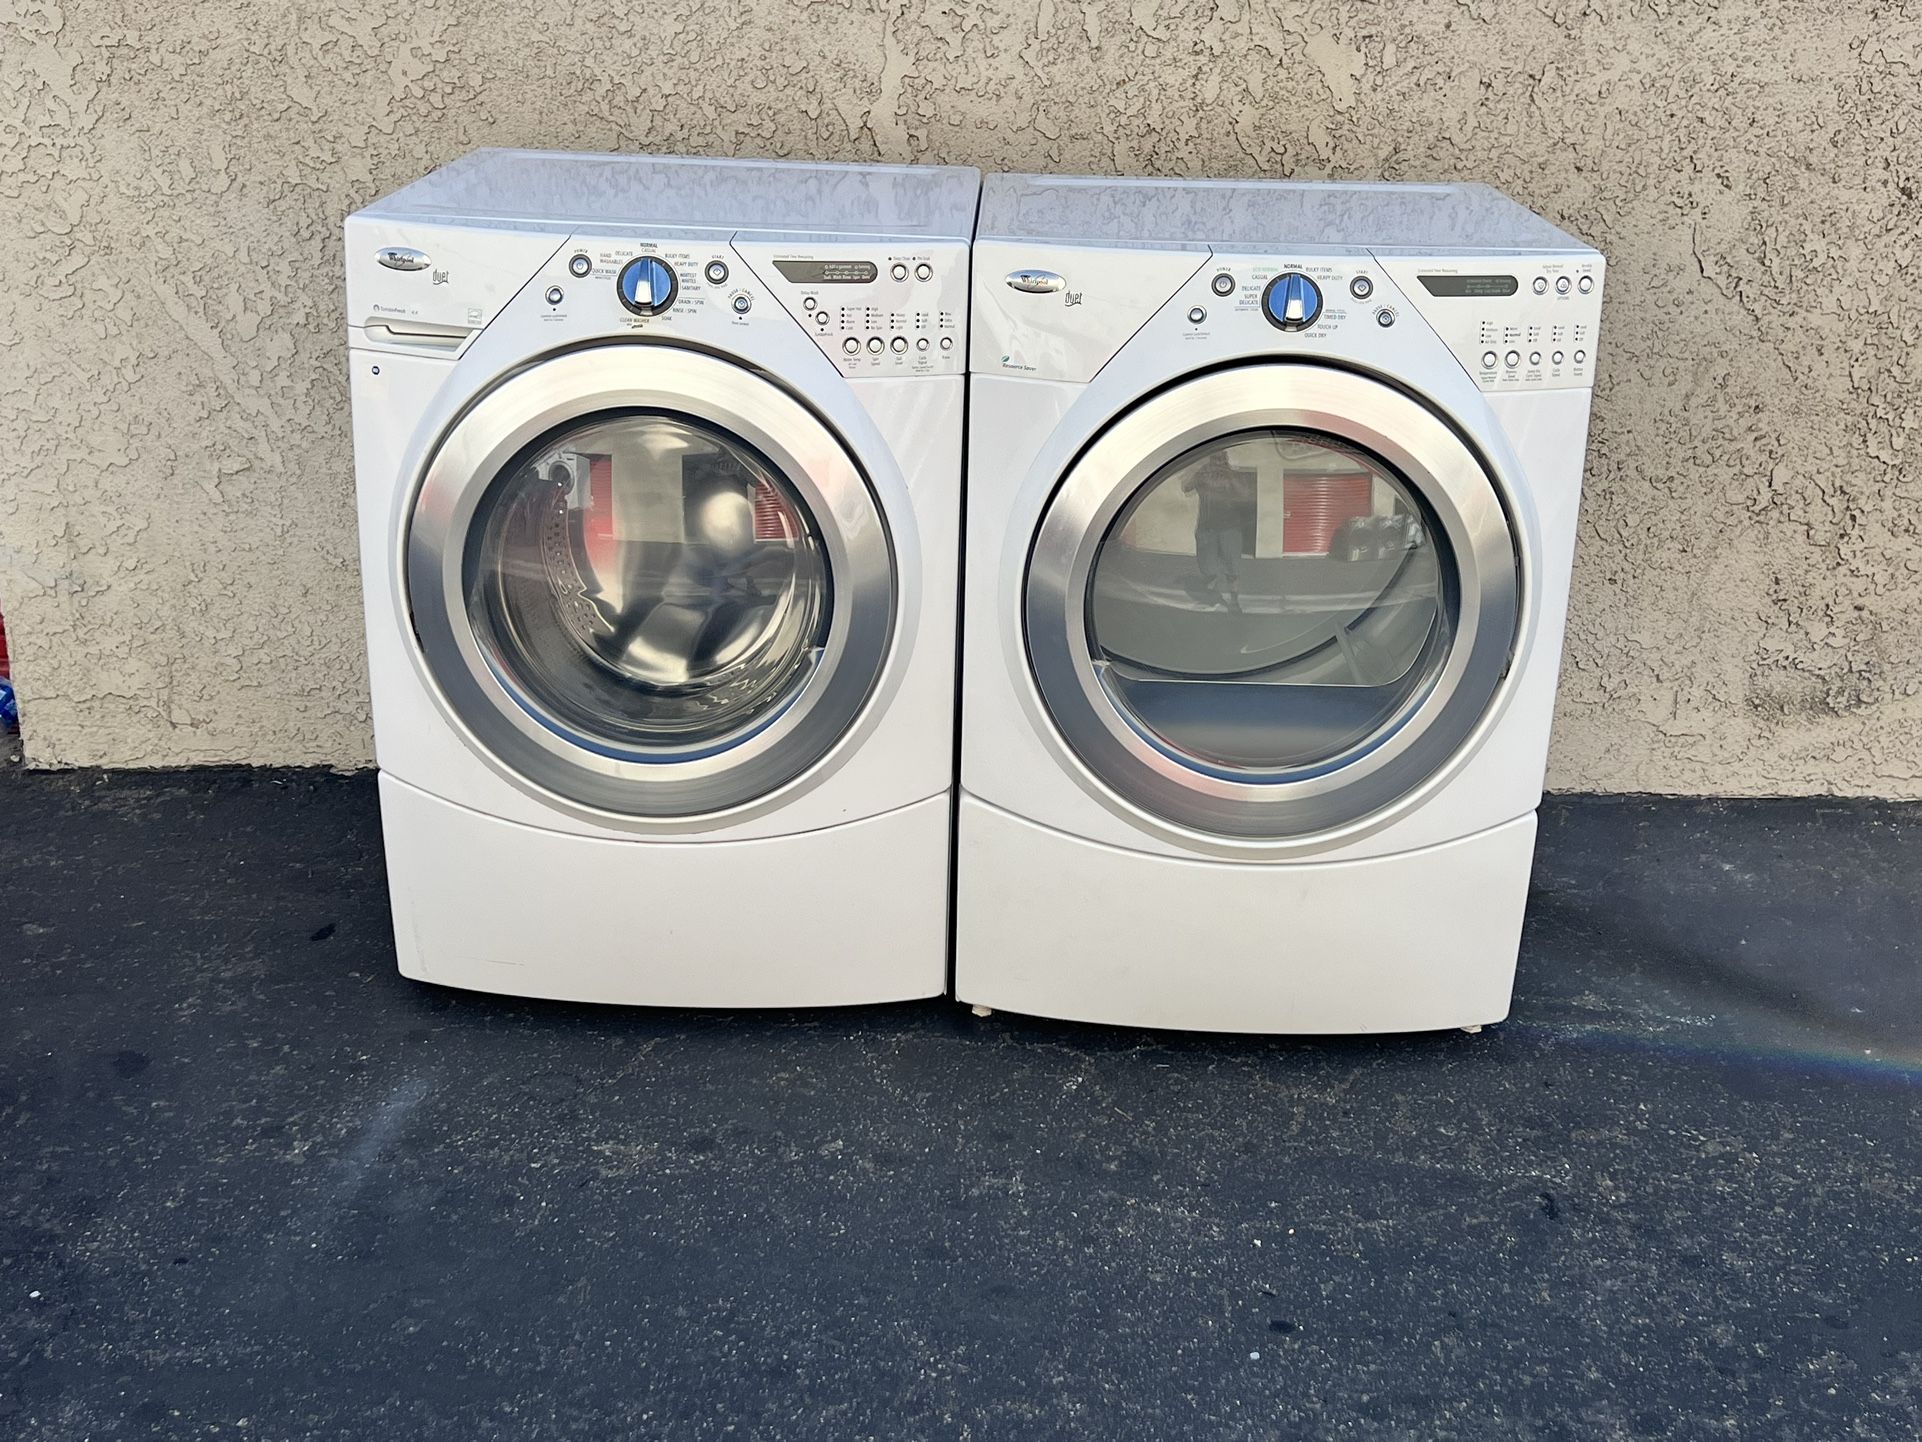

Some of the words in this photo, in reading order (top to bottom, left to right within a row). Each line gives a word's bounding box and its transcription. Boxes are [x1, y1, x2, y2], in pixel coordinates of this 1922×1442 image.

[387, 251, 415, 266] Whirlpool
[432, 269, 450, 284] duet
[1020, 274, 1048, 287] Whirlpool
[1065, 291, 1083, 306] duet
